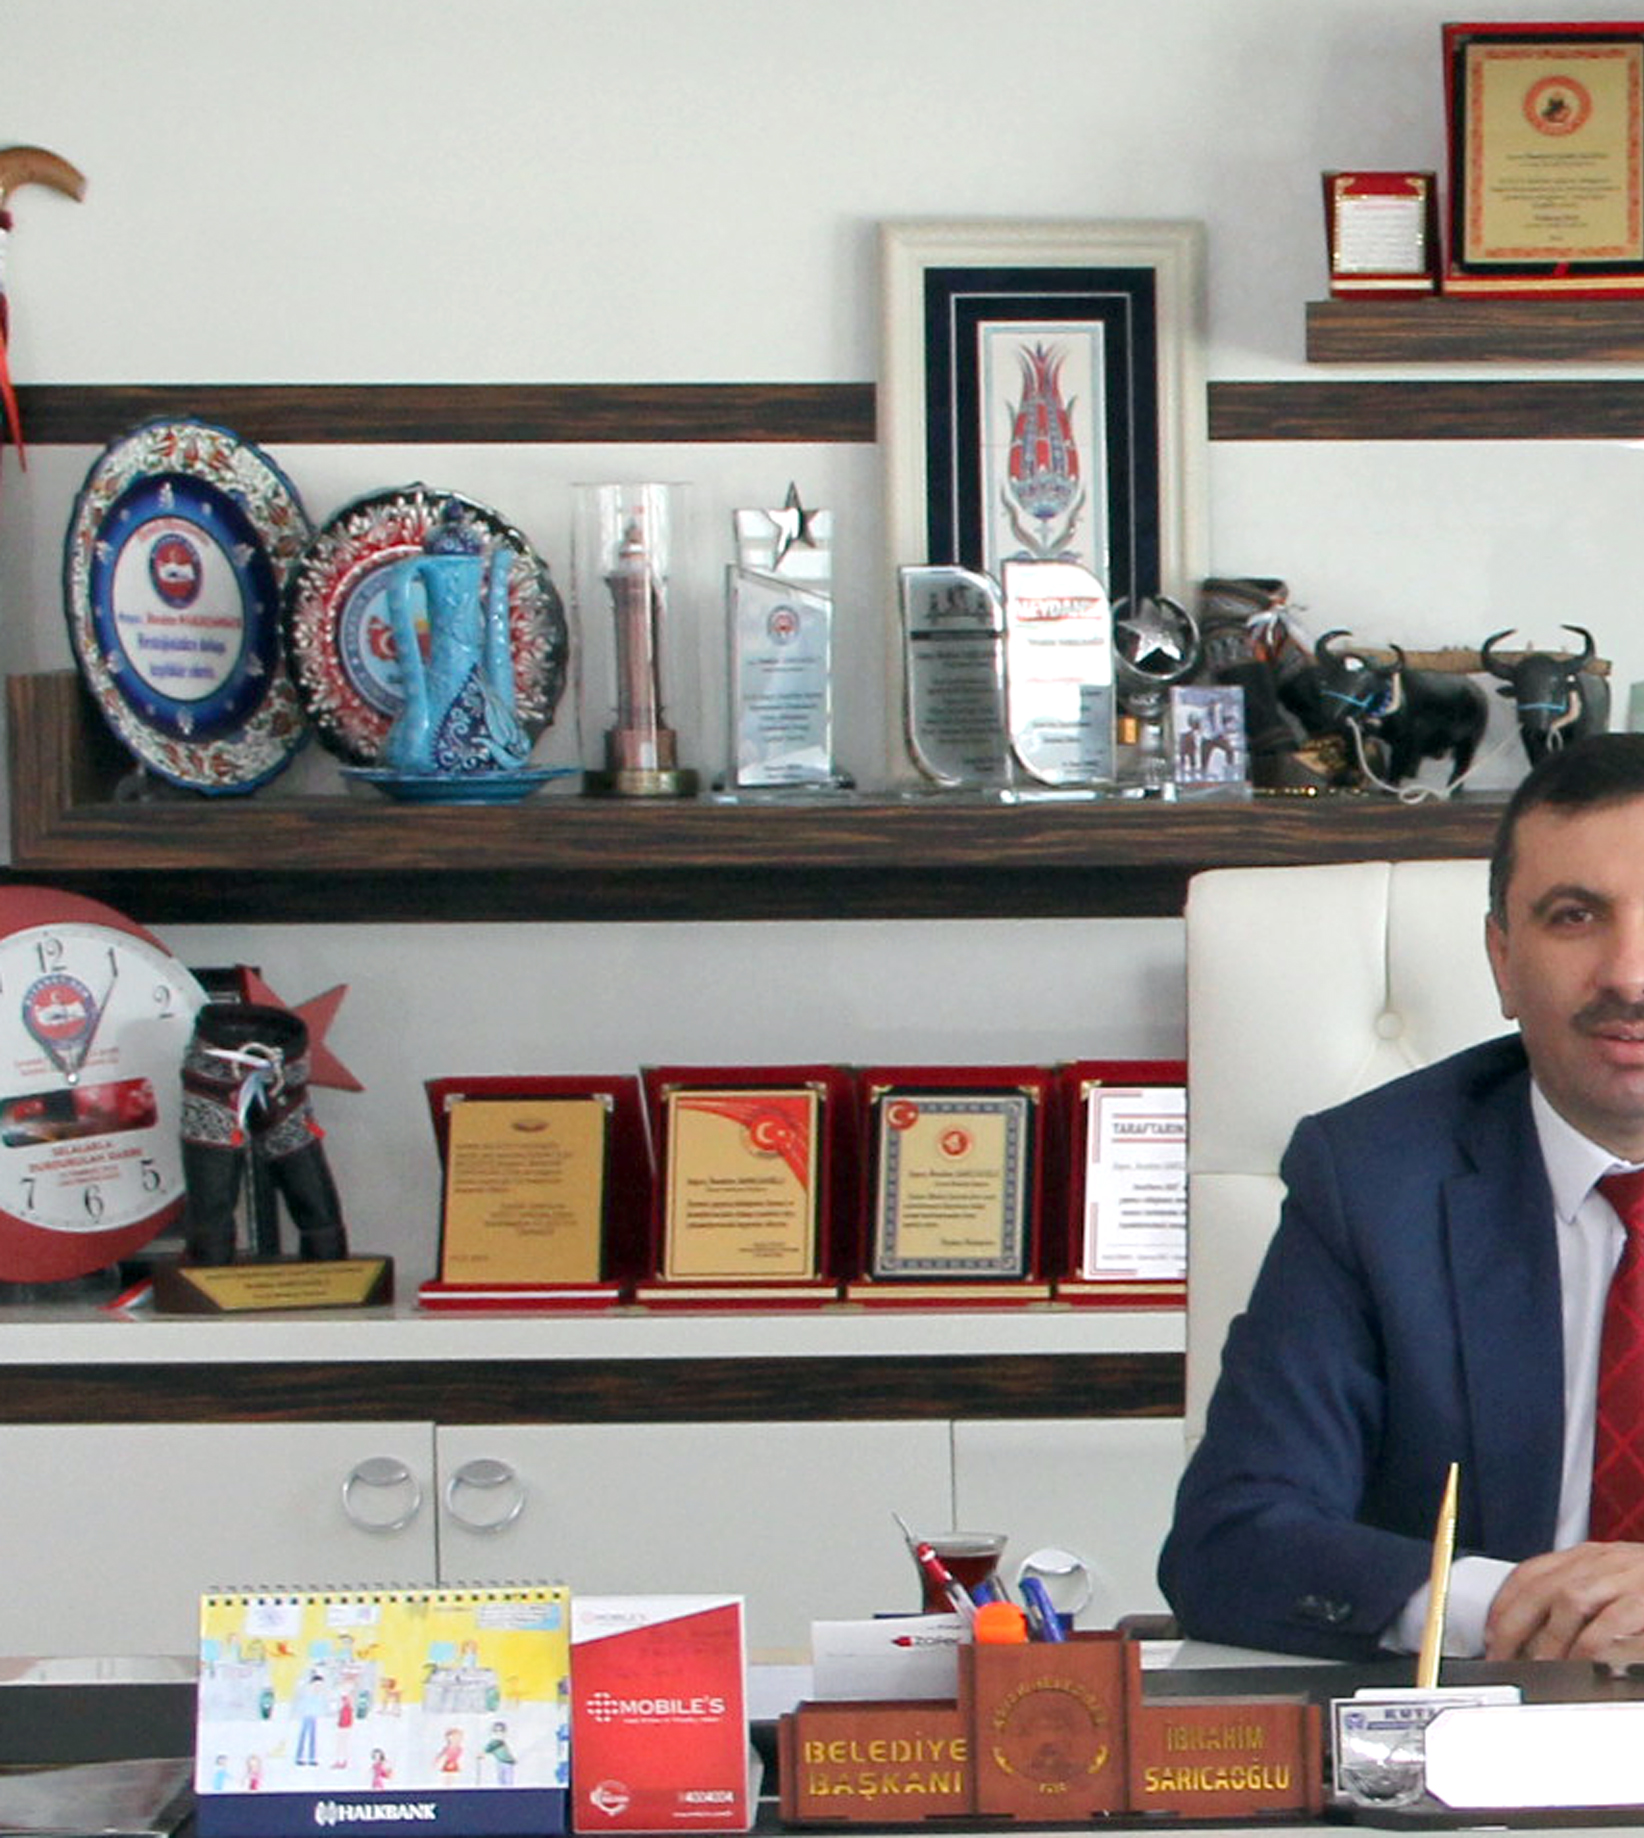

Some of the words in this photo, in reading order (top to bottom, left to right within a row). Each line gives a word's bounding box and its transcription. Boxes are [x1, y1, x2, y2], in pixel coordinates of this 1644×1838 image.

[36, 938, 68, 974] 12
[153, 985, 175, 1019] 2
[139, 1158, 162, 1192] 5
[19, 1177, 36, 1211] 7
[83, 1183, 105, 1219] 6
[619, 1695, 726, 1715] MOBILE'S
[804, 1731, 968, 1764] BELEDİYE
[1166, 1719, 1264, 1752] İBRAHİM
[809, 1772, 964, 1800] BAŞKANI
[1144, 1756, 1290, 1792] SARICAOĞLU
[339, 1803, 438, 1821] HALKBANK
